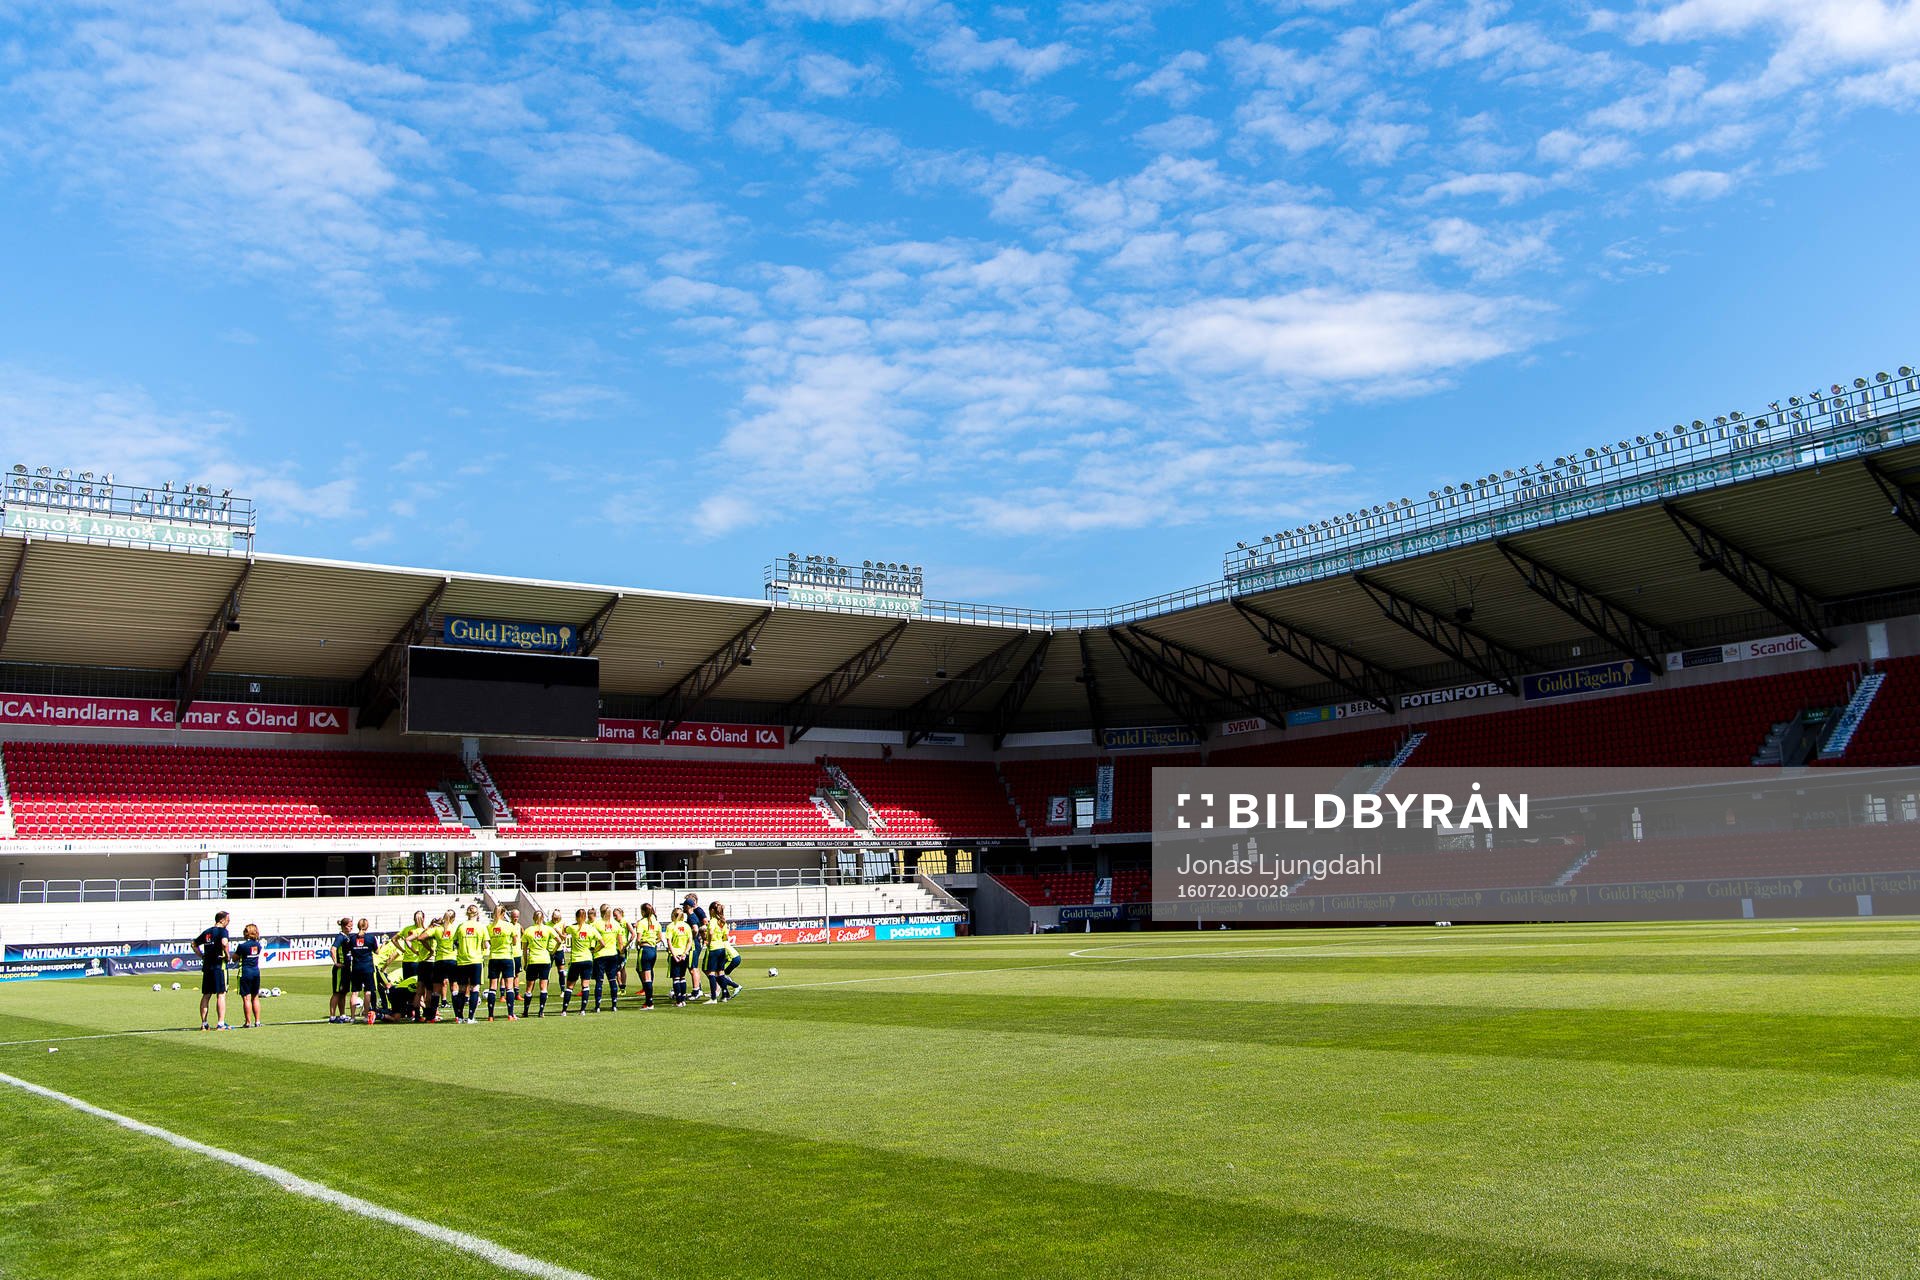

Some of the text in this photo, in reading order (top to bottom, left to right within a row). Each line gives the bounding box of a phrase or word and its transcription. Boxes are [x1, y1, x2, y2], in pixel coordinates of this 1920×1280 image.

[451, 620, 558, 649] Guld Fågeln
[1750, 637, 1807, 656] Scandic
[1537, 674, 1572, 693] Guld
[150, 706, 221, 724] Kamar
[226, 709, 240, 724] &
[245, 708, 298, 726] Öland
[309, 711, 340, 728] ICA
[642, 726, 692, 741] Kamar
[697, 728, 707, 742] &
[710, 726, 747, 743] Öland
[1228, 719, 1259, 734] SVEVIA
[756, 730, 779, 744] ICA
[1103, 728, 1139, 745] Guld
[1707, 881, 1742, 898] Guld
[1828, 876, 1866, 893] Guld
[844, 914, 961, 927] NATIONALSPORTEN NATIONALSPORTEN
[1062, 908, 1083, 919] Guld
[759, 920, 819, 930] NATIONALSPORTEN
[890, 926, 941, 939] postnord
[837, 927, 870, 942] Estrella
[22, 945, 122, 960] NATIONALSPORTEN
[115, 962, 133, 971] ALLA
[147, 960, 168, 968] OLIKA
